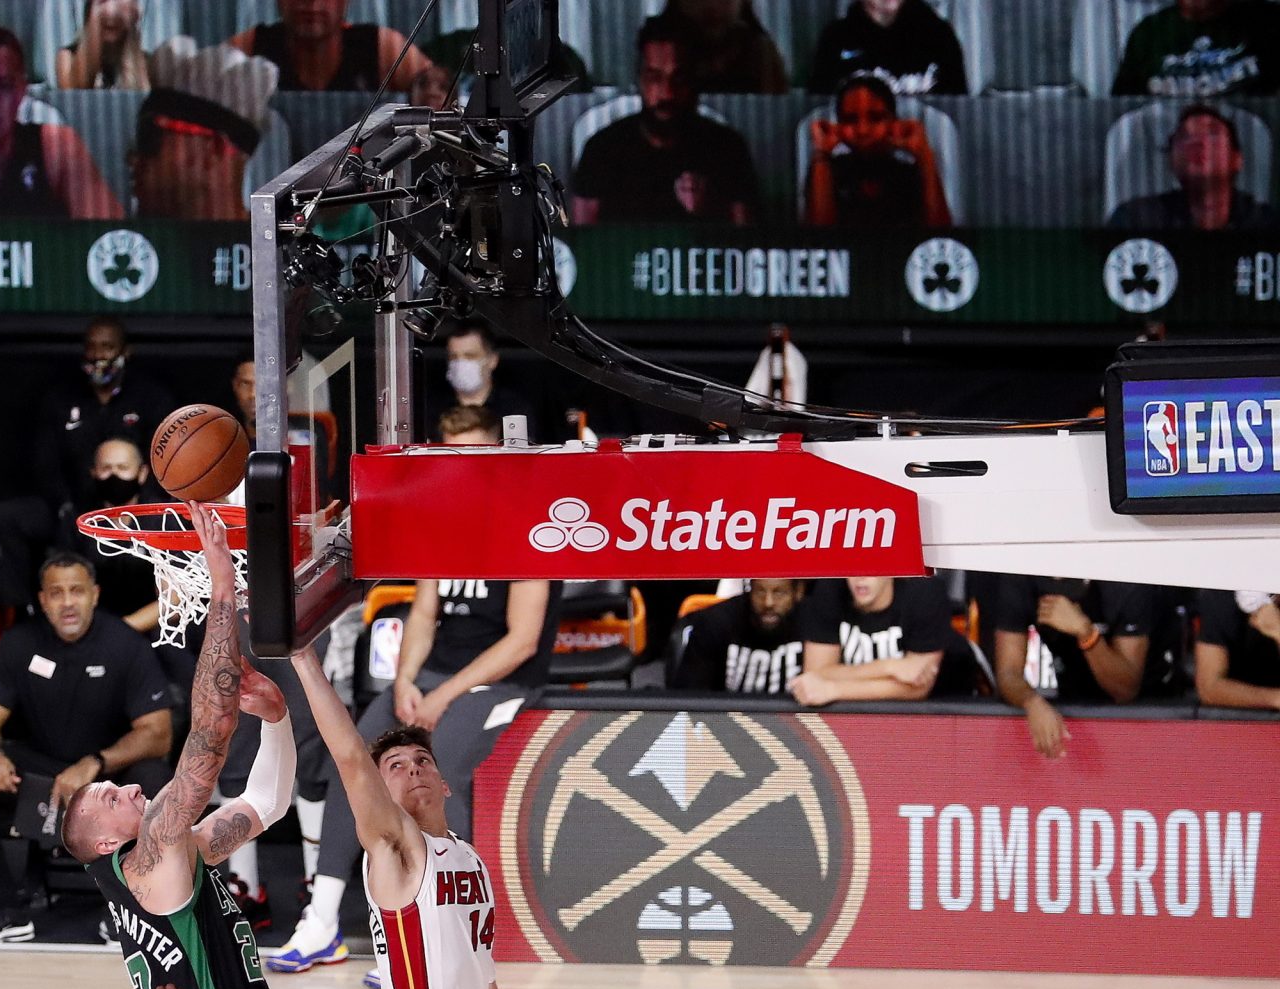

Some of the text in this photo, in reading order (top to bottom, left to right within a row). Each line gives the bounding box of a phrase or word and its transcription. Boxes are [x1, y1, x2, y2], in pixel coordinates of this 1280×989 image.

[631, 247, 850, 297] #BLEEDGREEN
[1151, 459, 1167, 471] NBA
[898, 803, 1262, 918] TOMORROW
[469, 907, 494, 952] 14
